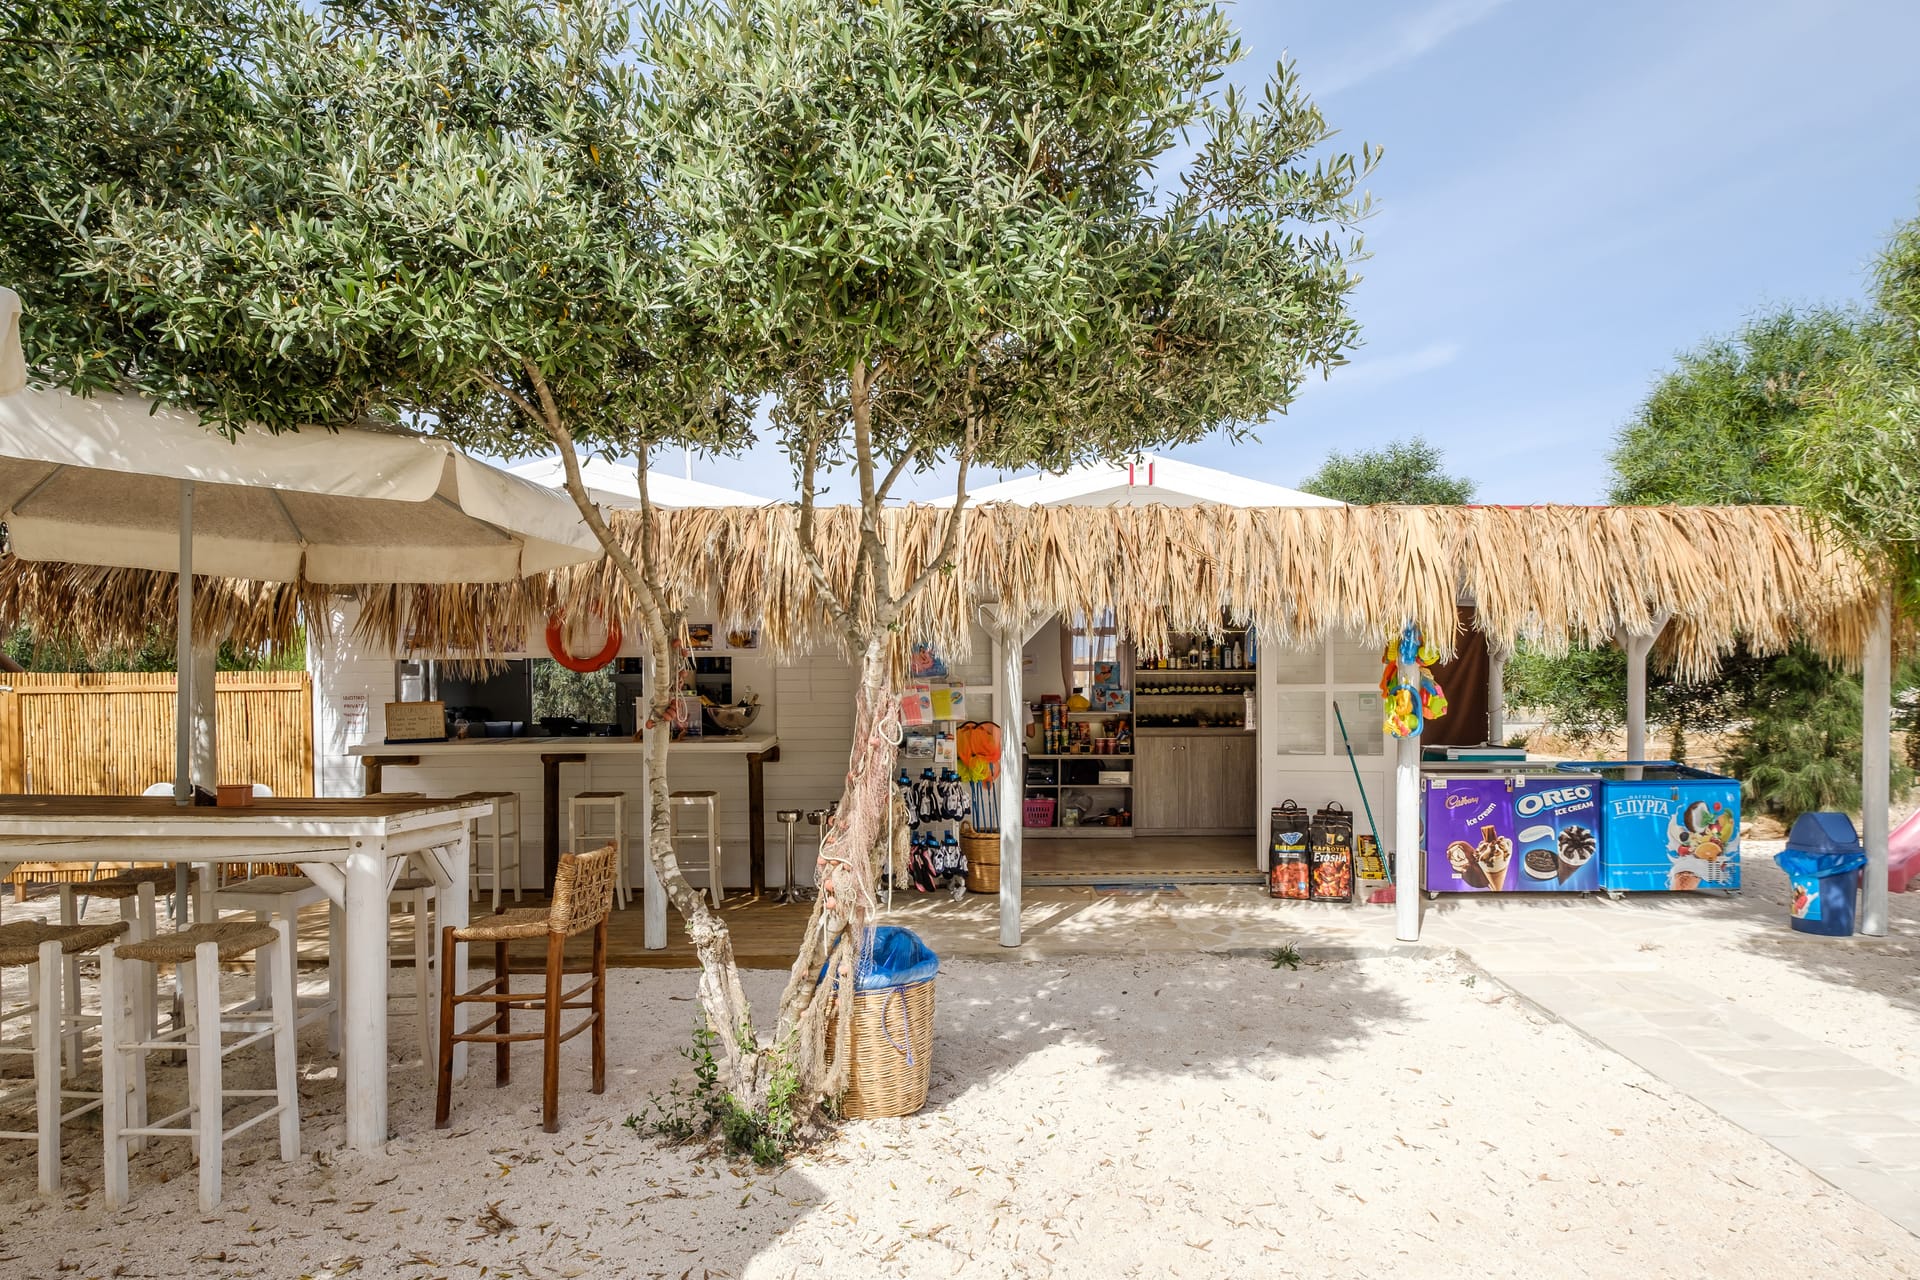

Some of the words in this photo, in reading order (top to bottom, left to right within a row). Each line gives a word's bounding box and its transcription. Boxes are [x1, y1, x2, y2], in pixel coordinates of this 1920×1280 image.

[1445, 795, 1479, 810] Cadbury
[1518, 786, 1591, 815] OREO
[1554, 807, 1568, 816] ICE
[1567, 801, 1594, 813] CREAM
[1466, 817, 1478, 826] Ice
[1477, 803, 1497, 821] cream
